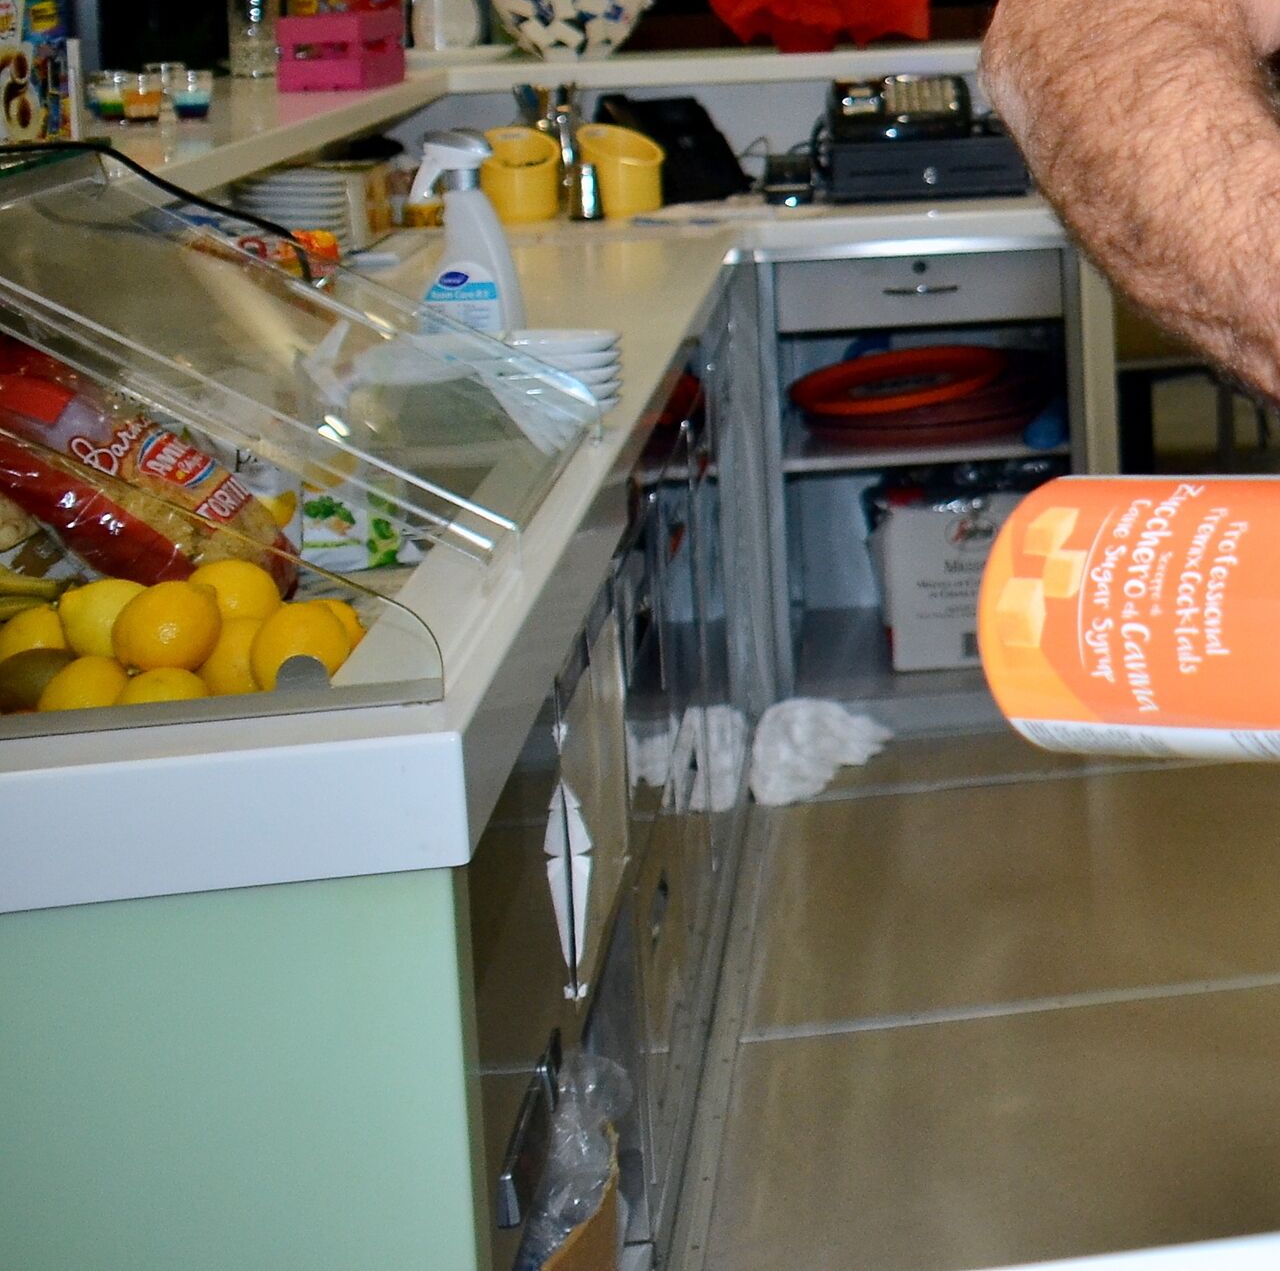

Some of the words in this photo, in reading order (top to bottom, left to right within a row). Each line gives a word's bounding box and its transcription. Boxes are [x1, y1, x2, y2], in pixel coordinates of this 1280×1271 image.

[1112, 498, 1153, 539] Cane
[1123, 483, 1206, 598] Zucchero
[1184, 507, 1229, 569] Premix
[1090, 544, 1128, 610] Sugar
[1203, 520, 1250, 656] Professional
[1085, 617, 1116, 684] Syrup
[1173, 570, 1203, 675] Cocktails
[1120, 621, 1160, 713] Canna
